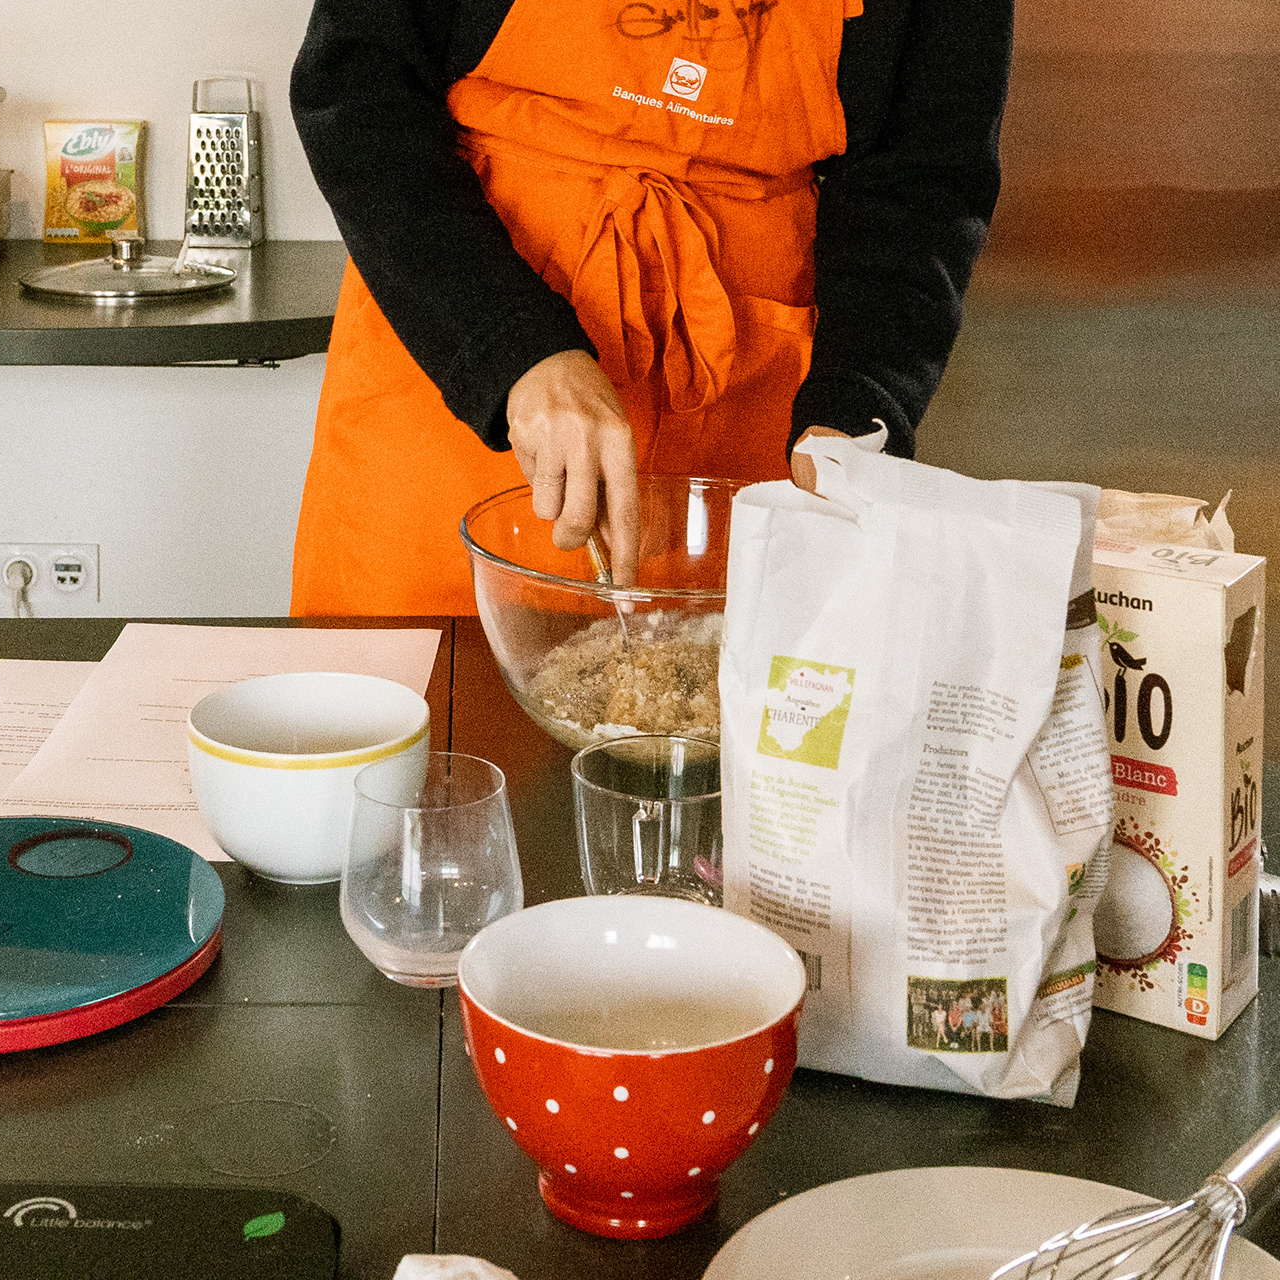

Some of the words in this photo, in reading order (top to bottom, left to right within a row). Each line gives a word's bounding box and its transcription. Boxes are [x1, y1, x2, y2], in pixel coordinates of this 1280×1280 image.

[612, 86, 664, 109] Banques
[665, 100, 735, 127] Alimentaires
[66, 131, 111, 154] Ebly
[1104, 672, 1173, 751] IO
[1112, 761, 1168, 788] Blanc
